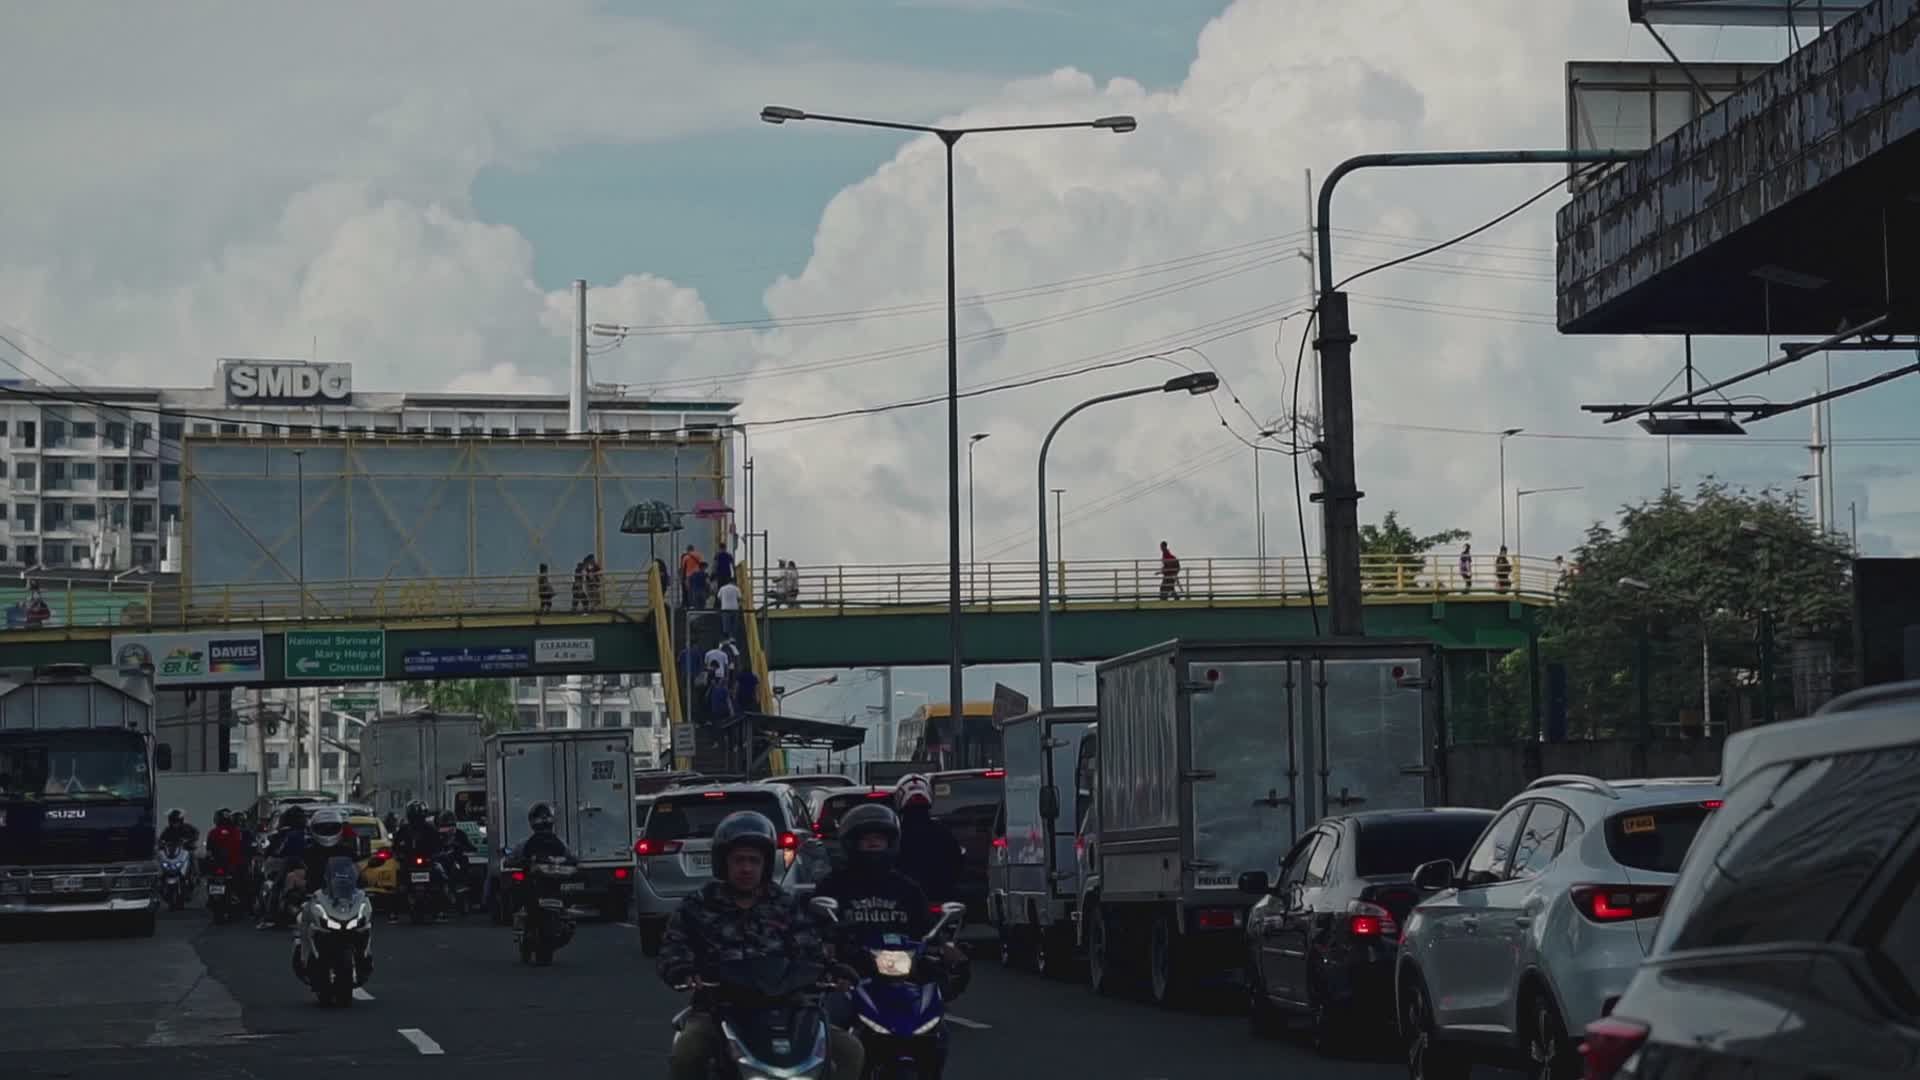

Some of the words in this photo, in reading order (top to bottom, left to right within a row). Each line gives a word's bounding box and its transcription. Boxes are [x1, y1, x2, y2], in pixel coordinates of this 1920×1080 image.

[230, 366, 350, 399] SMDC
[288, 636, 331, 646] National
[335, 636, 368, 646] Shrine
[369, 636, 381, 645] of
[212, 646, 257, 657] DAVIES
[315, 649, 342, 660] Mary
[344, 649, 368, 660] Help
[369, 649, 381, 658] of
[45, 809, 86, 819] ISUZU
